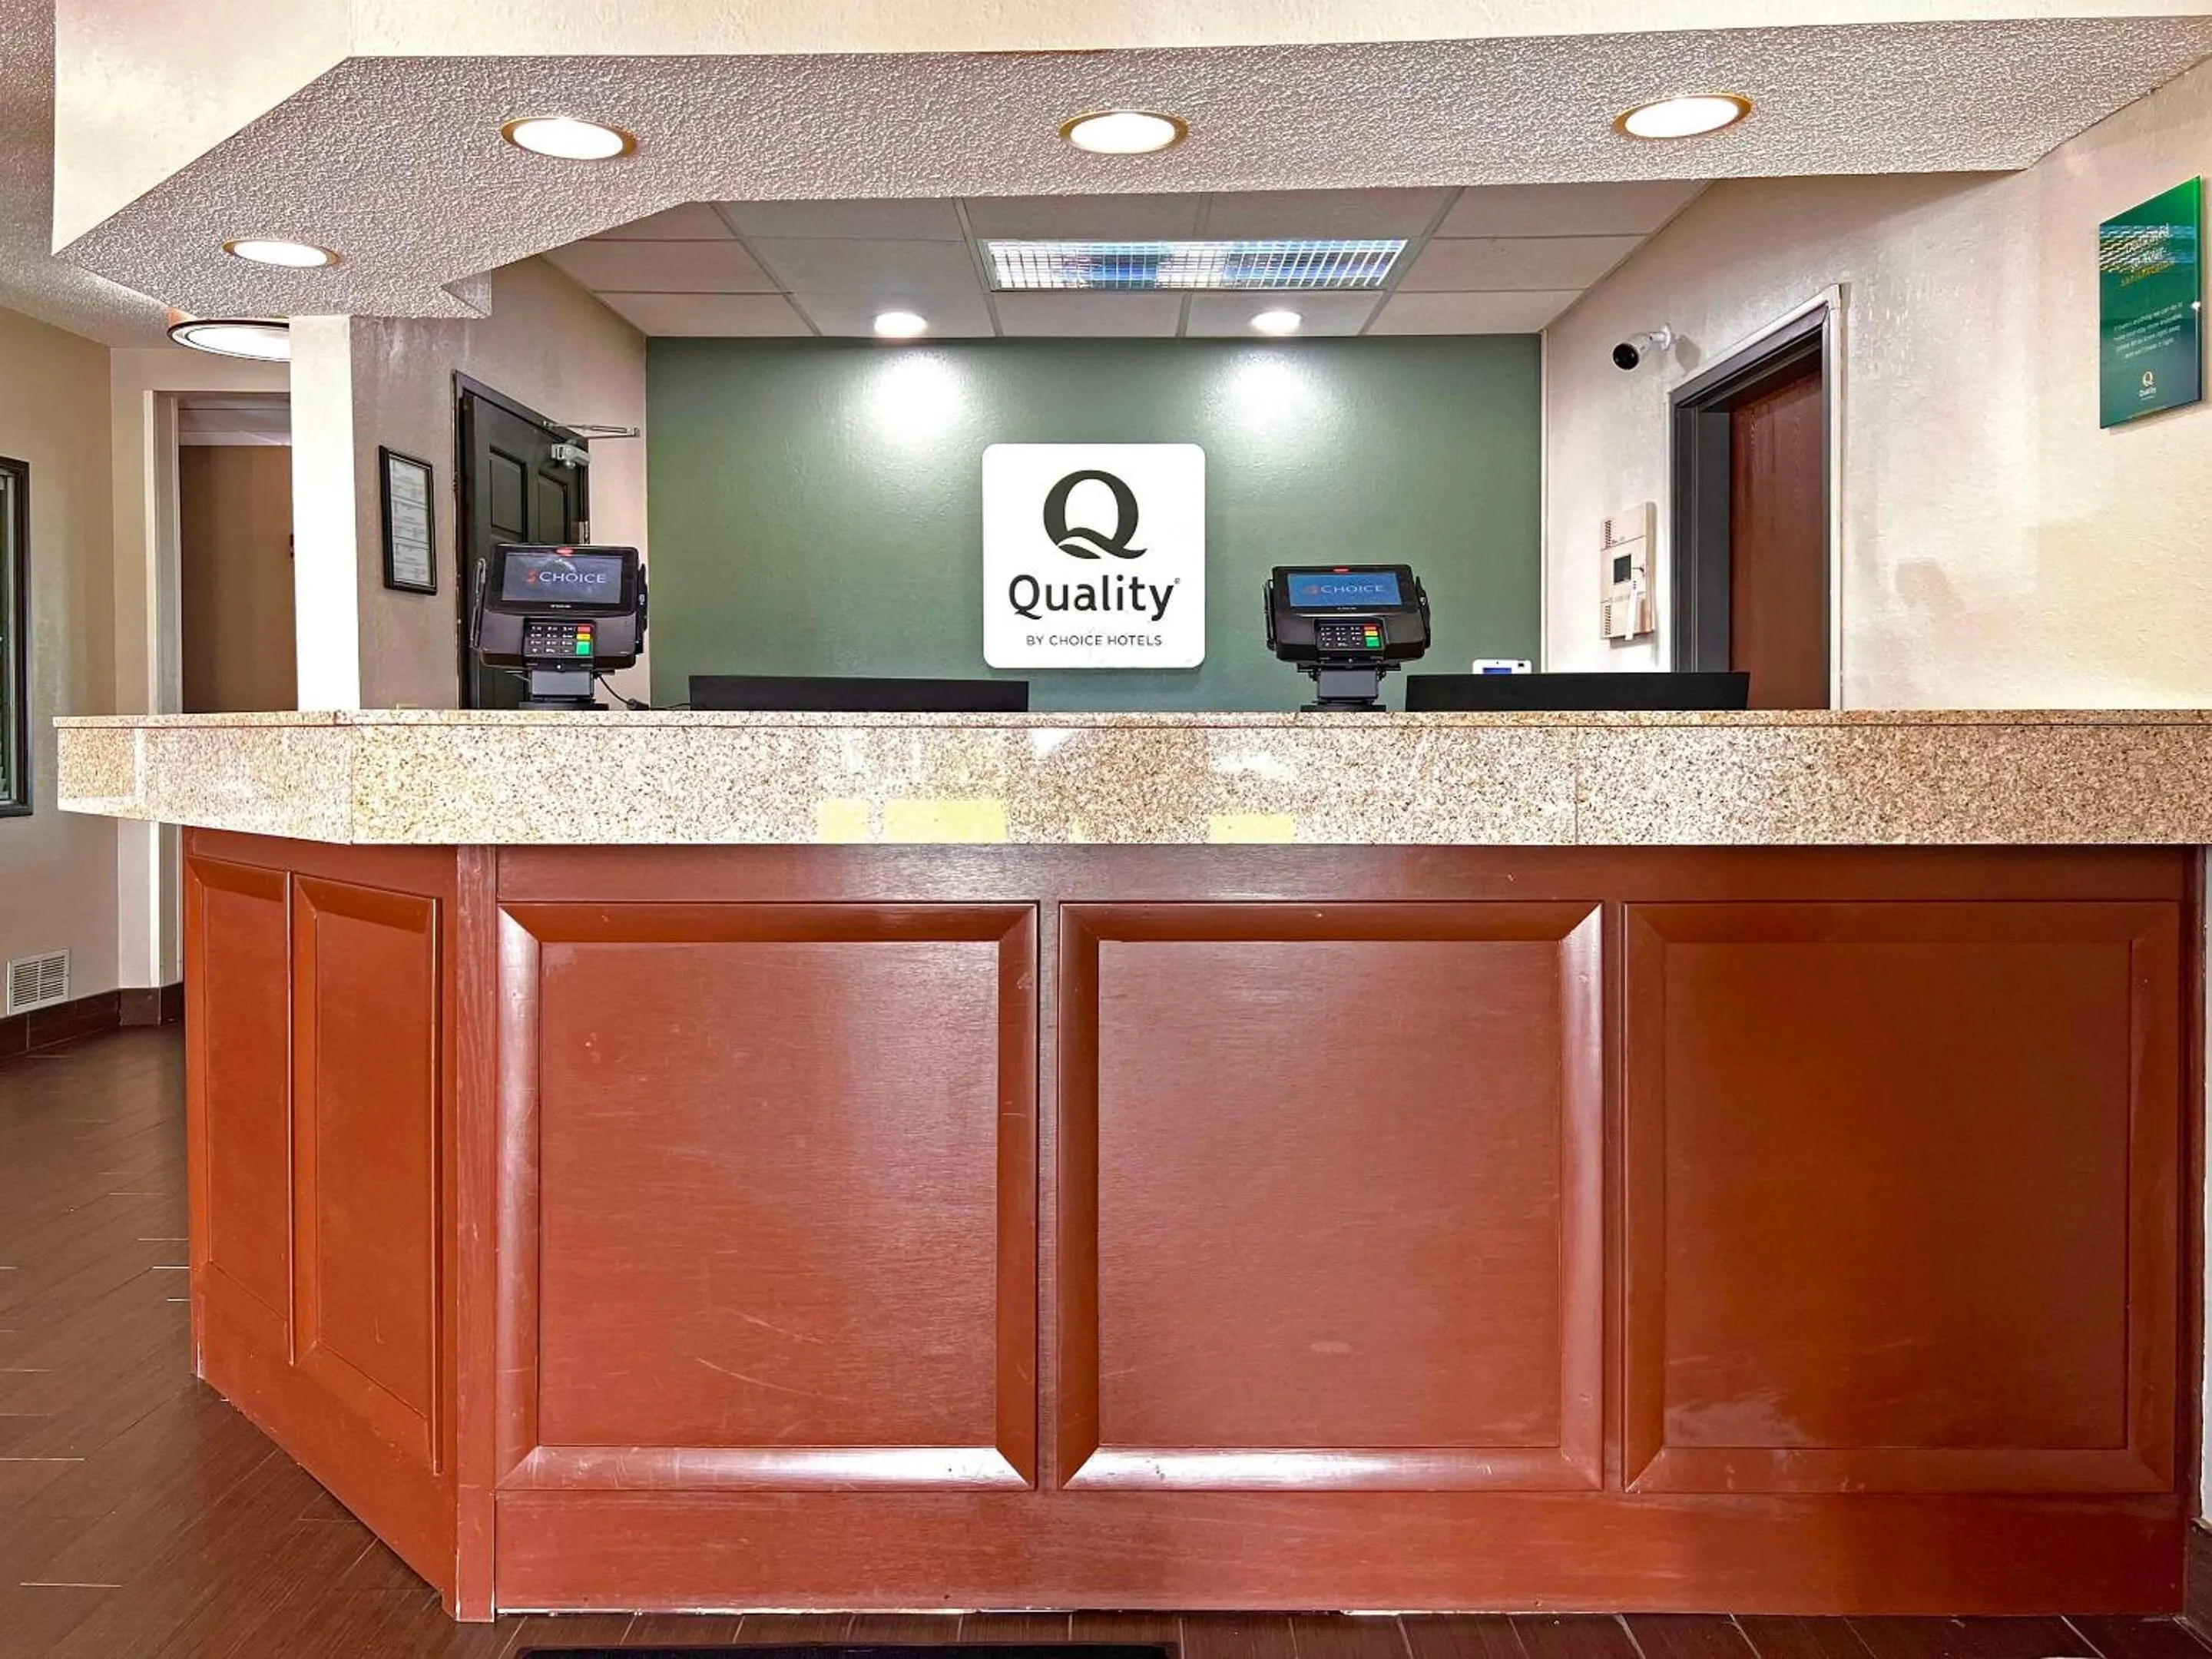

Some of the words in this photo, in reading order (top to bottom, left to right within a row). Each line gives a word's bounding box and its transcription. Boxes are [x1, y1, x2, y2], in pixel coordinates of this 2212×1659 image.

[1043, 469, 1147, 559] Q
[539, 571, 606, 584] CHOICE
[1320, 584, 1384, 594] CHOICE
[1026, 634, 1044, 646] BY
[1049, 634, 1102, 646] CHOICE
[1107, 634, 1163, 646] HOTELS
